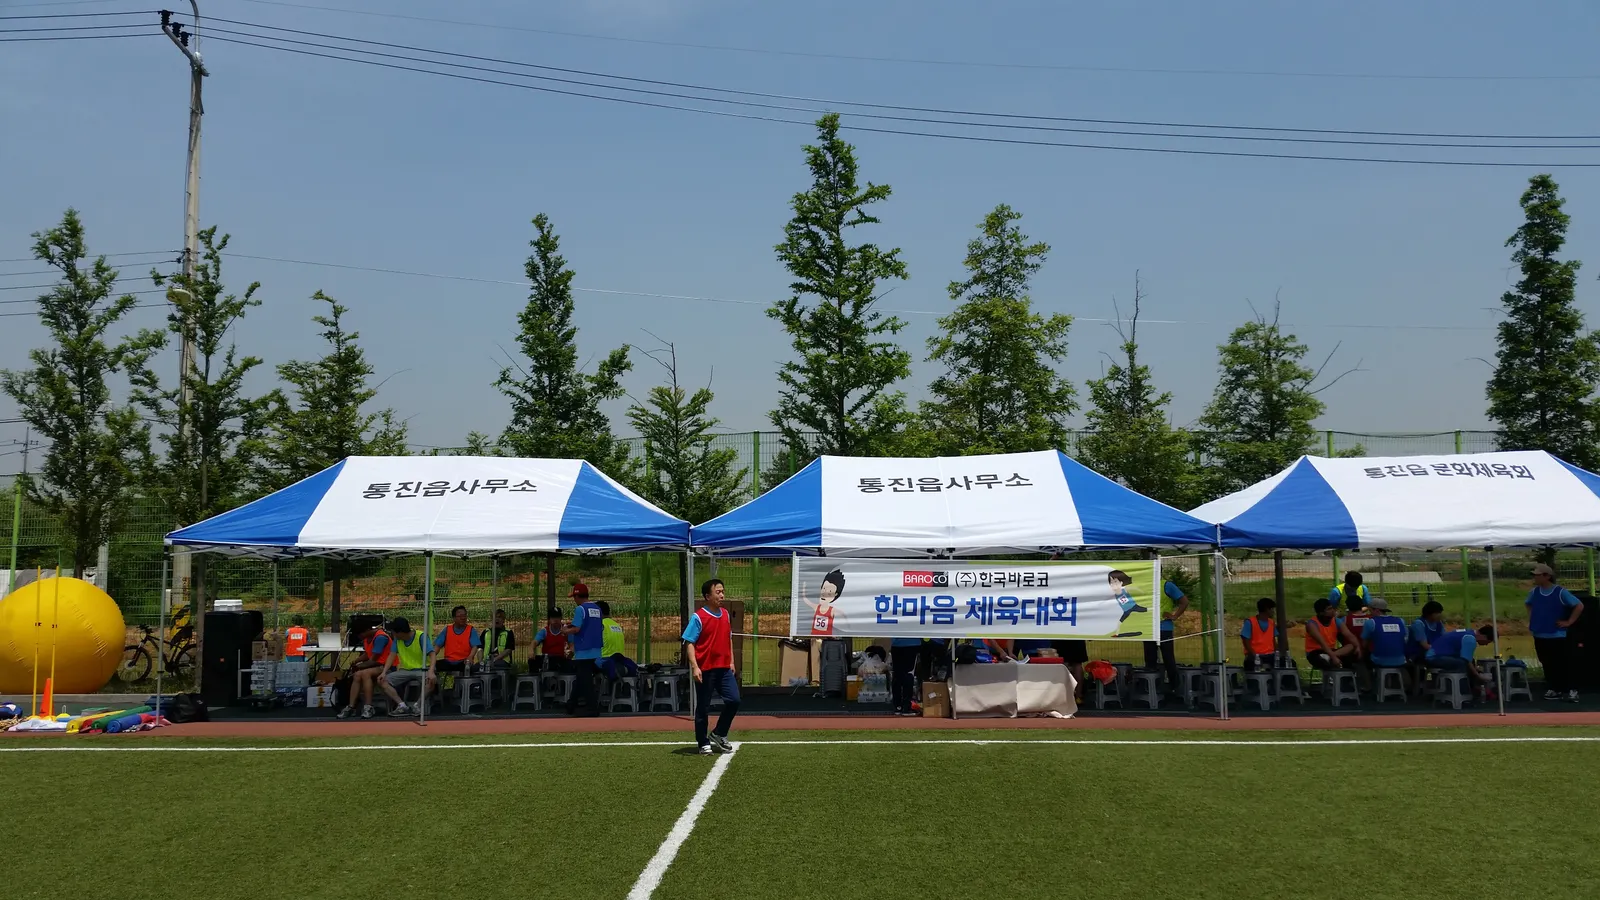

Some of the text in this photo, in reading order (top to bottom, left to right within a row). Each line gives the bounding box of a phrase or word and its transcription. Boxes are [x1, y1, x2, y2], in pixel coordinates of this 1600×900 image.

[1363, 463, 1429, 479] 통진읍
[362, 479, 538, 499] 통진읍사무소
[857, 472, 1034, 494] 통진읍사무소
[904, 573, 948, 585] BAROCO
[955, 571, 1049, 588] (주)한국바로코
[874, 594, 1078, 627] 한마음 체육대회
[816, 617, 826, 628] 56
